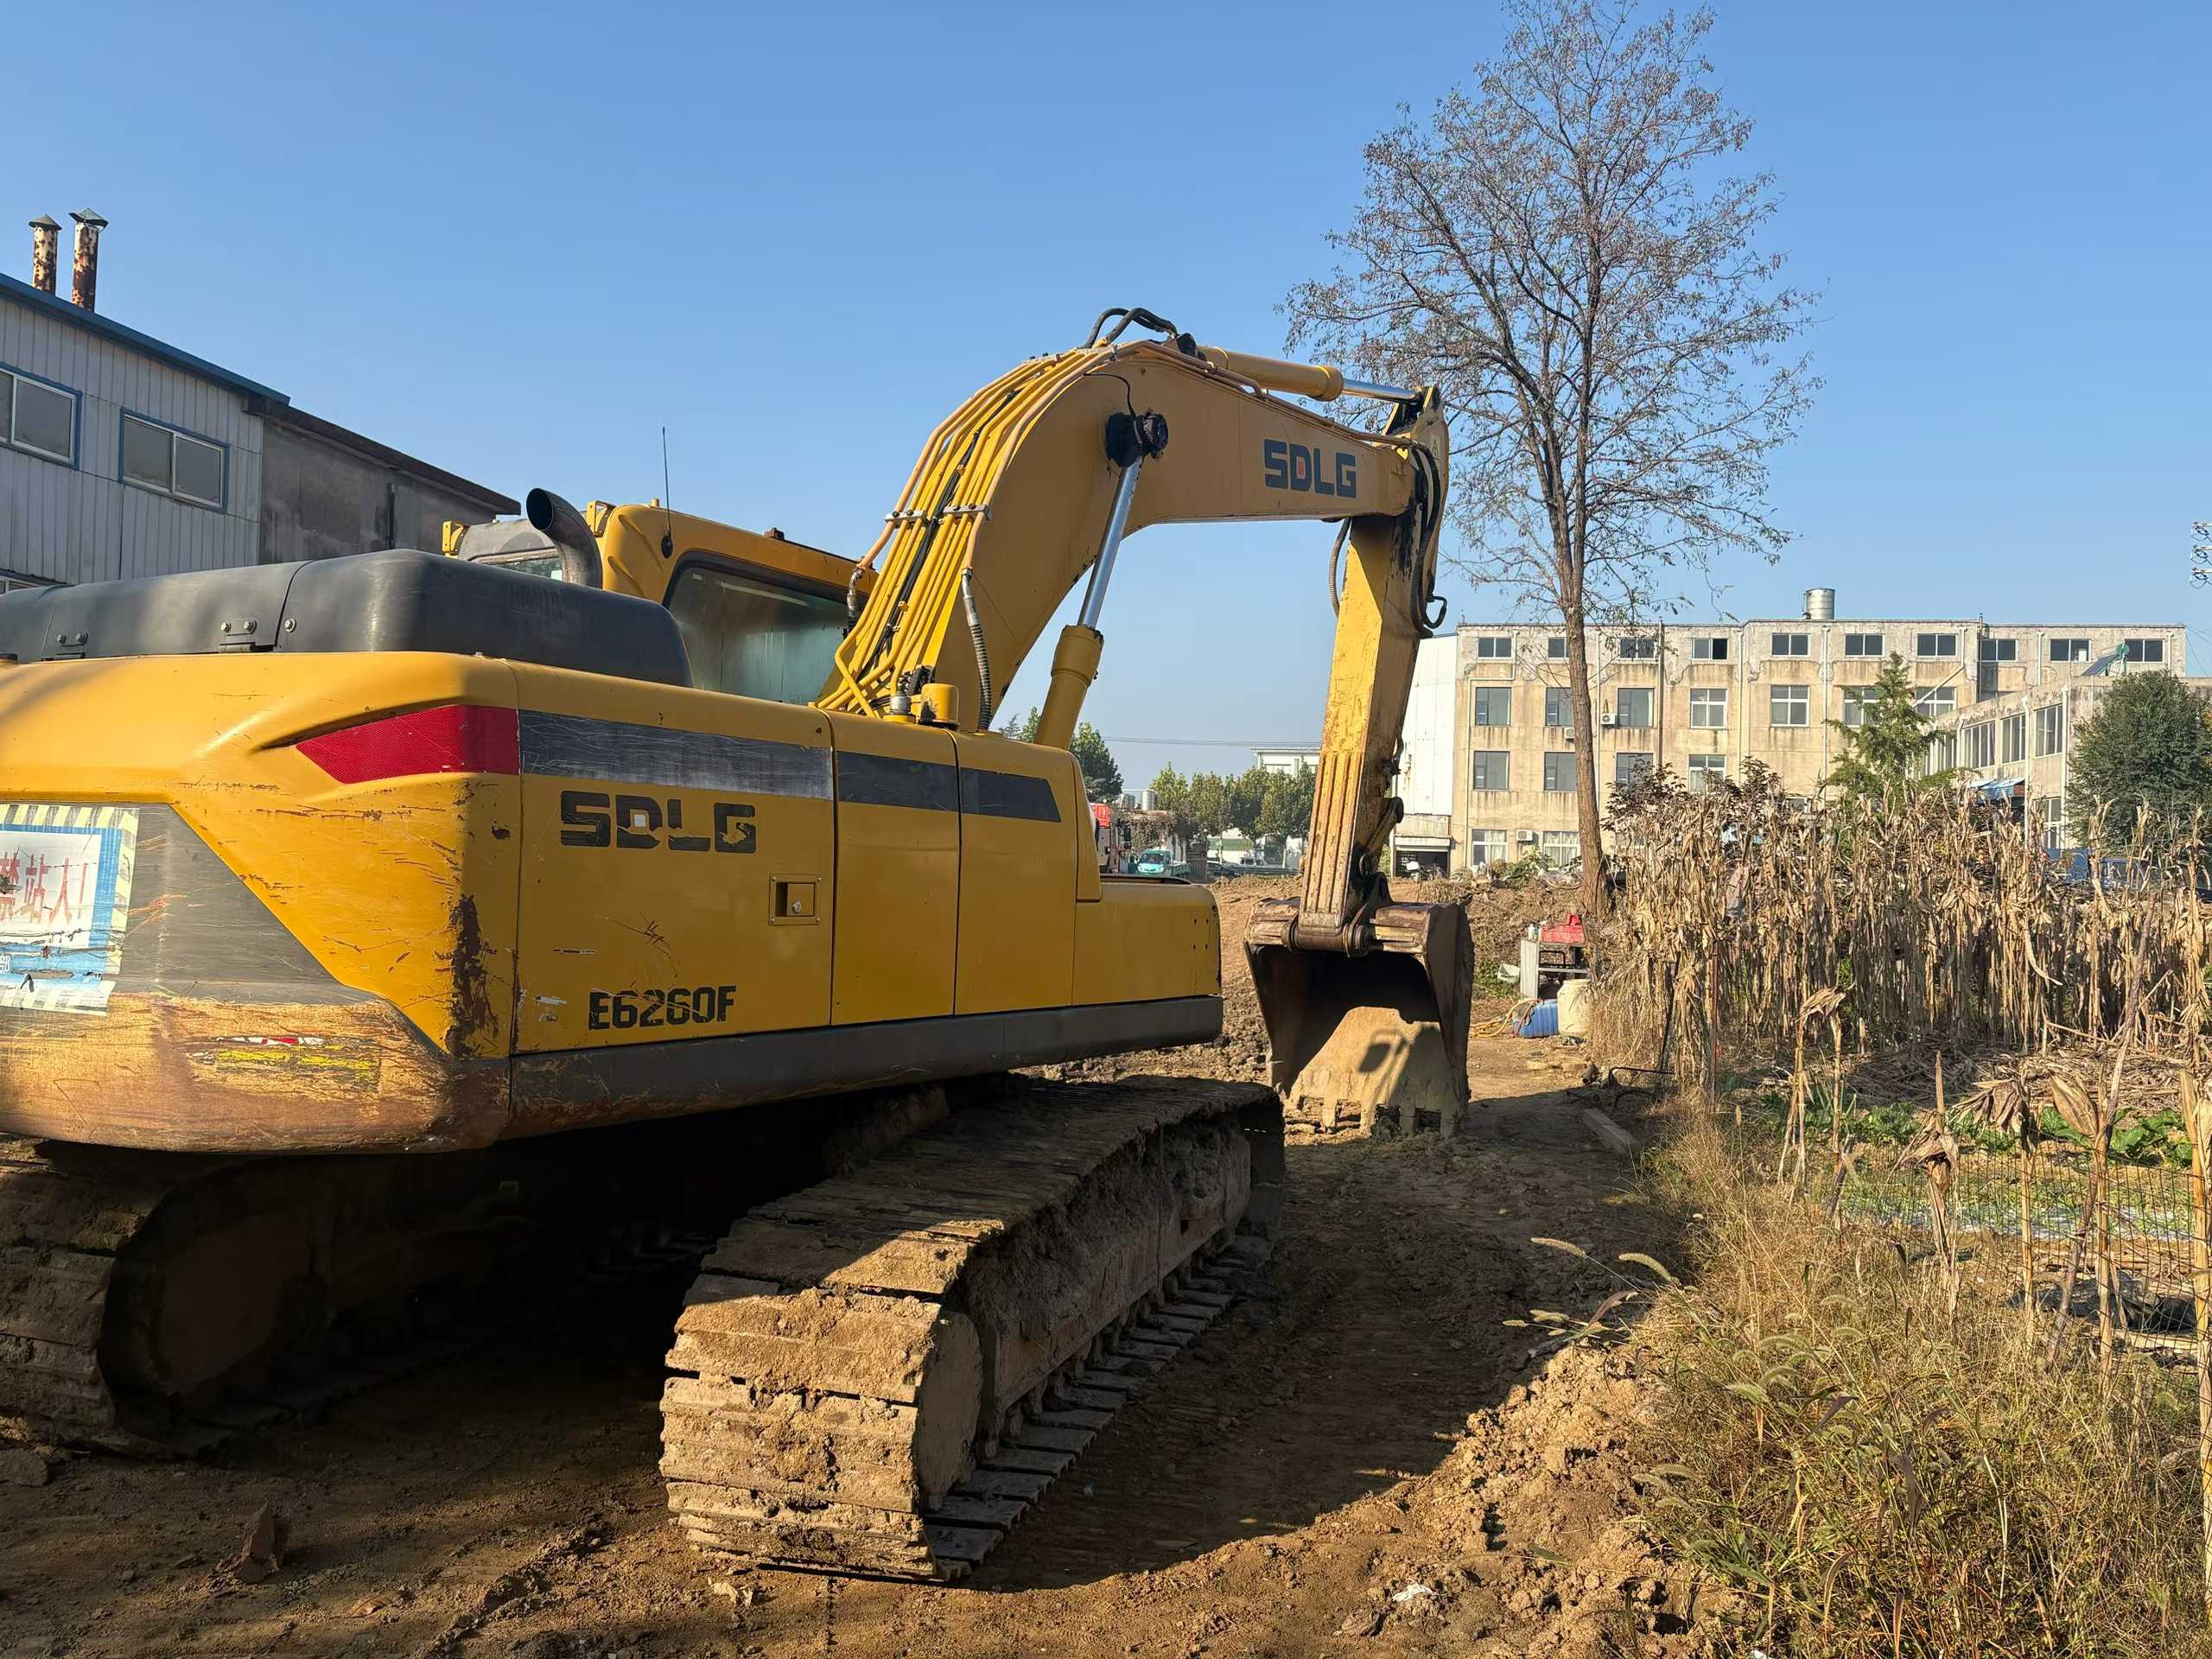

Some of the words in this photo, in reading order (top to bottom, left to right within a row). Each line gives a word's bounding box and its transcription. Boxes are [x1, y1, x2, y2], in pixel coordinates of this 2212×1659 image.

[1263, 438, 1357, 499] SDLG
[560, 790, 756, 854] SDLG
[588, 985, 737, 1030] E6260F
